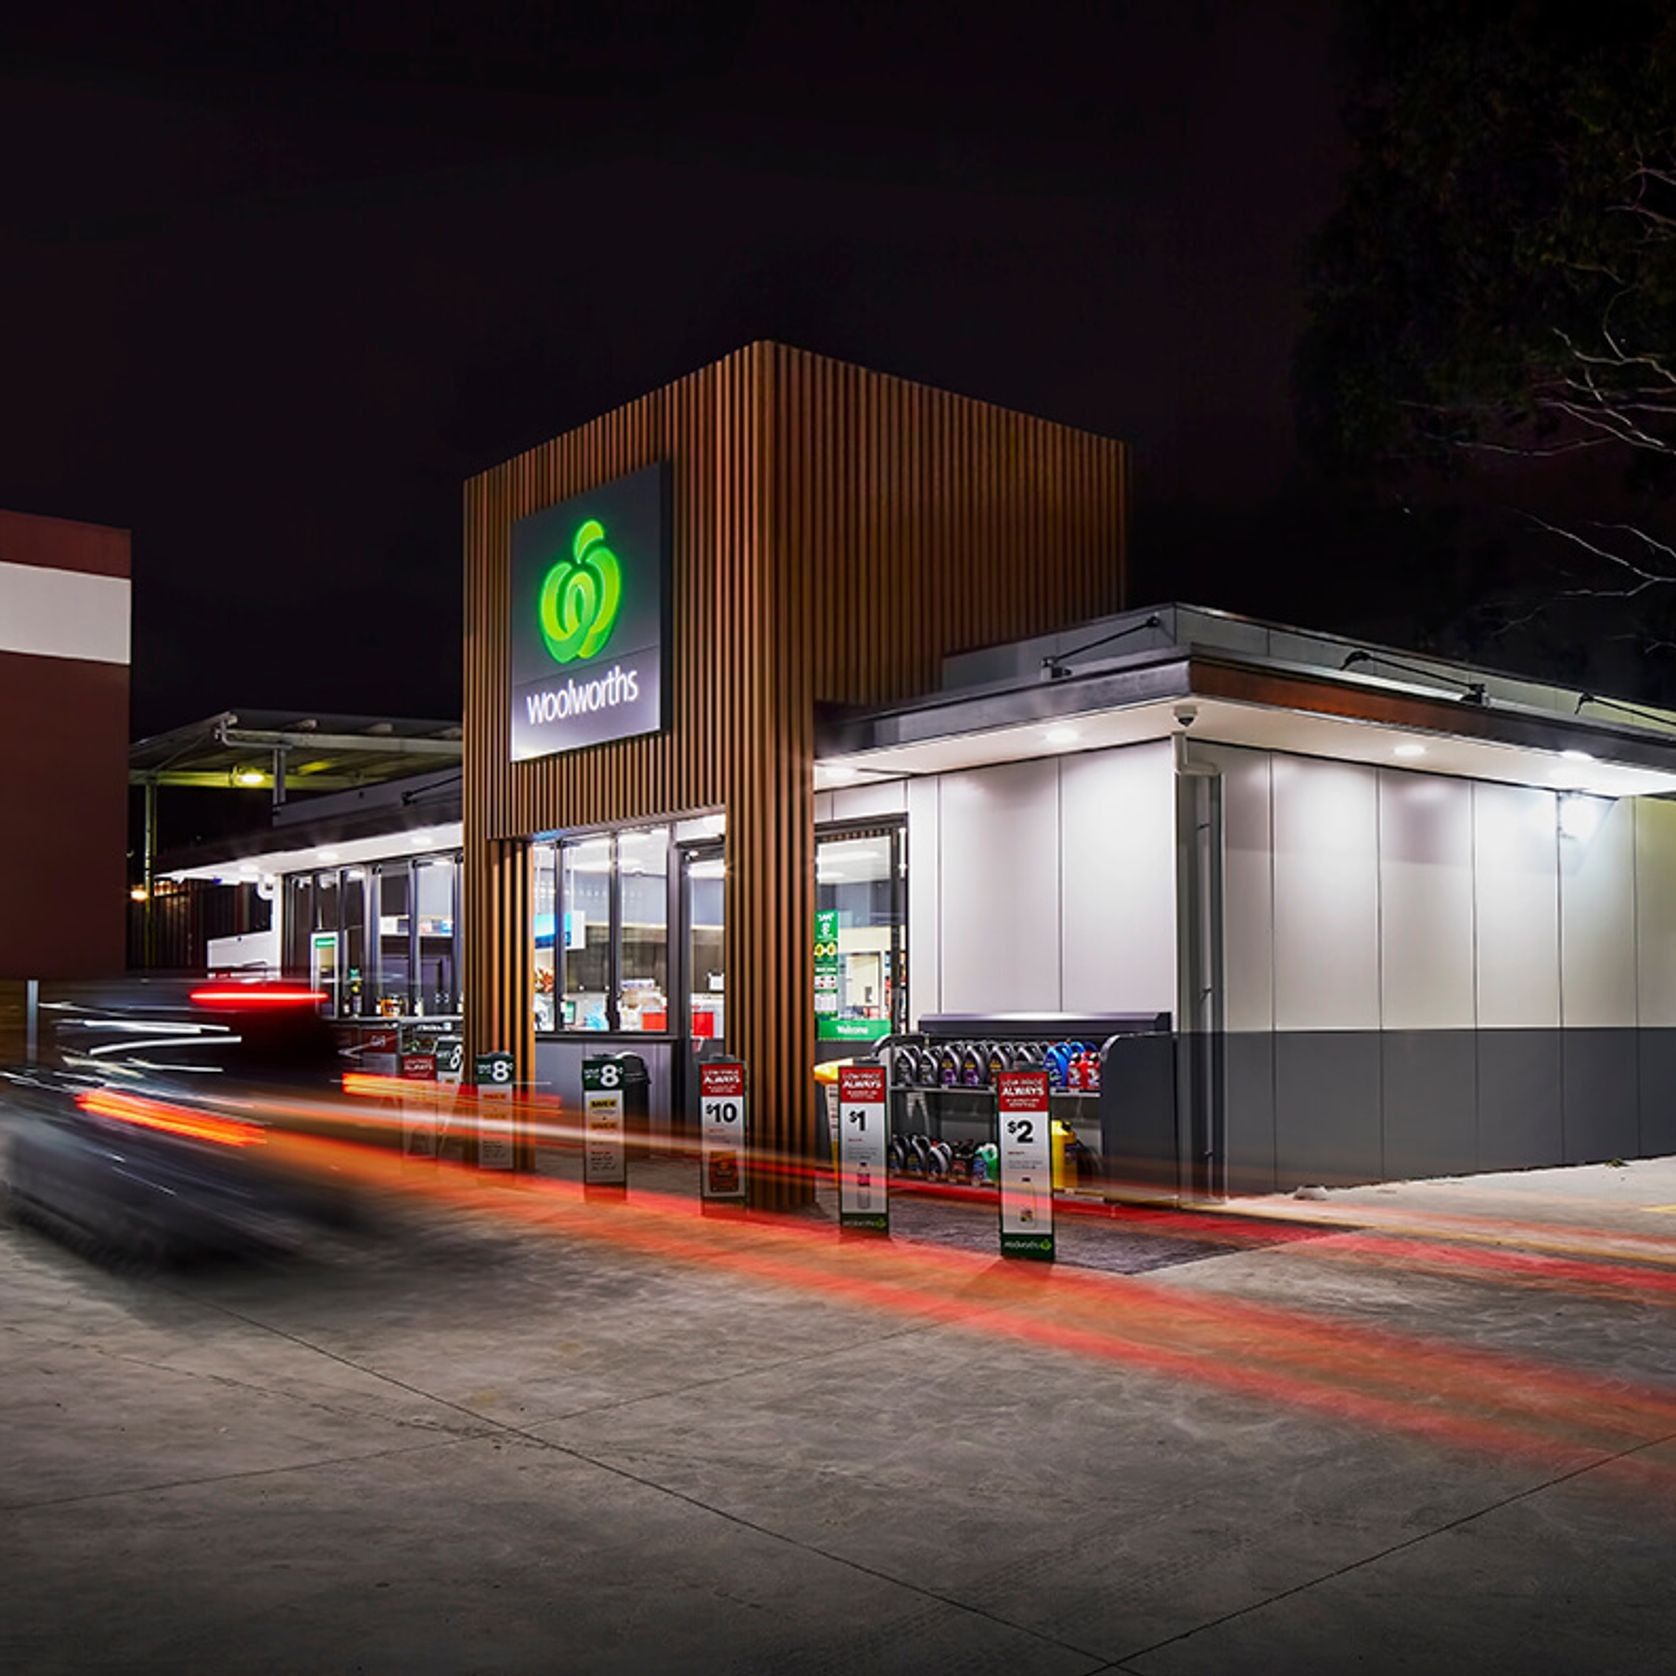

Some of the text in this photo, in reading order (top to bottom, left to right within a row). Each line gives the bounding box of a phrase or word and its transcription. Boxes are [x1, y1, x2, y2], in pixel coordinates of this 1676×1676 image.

[526, 665, 639, 725] woolworths
[703, 1075, 741, 1084] ALWAYS
[842, 1080, 882, 1089] ALWAYS
[1001, 1086, 1045, 1096] ALWAYS
[706, 1103, 737, 1123] $10
[849, 1110, 866, 1131] $1
[1007, 1120, 1034, 1144] $2
